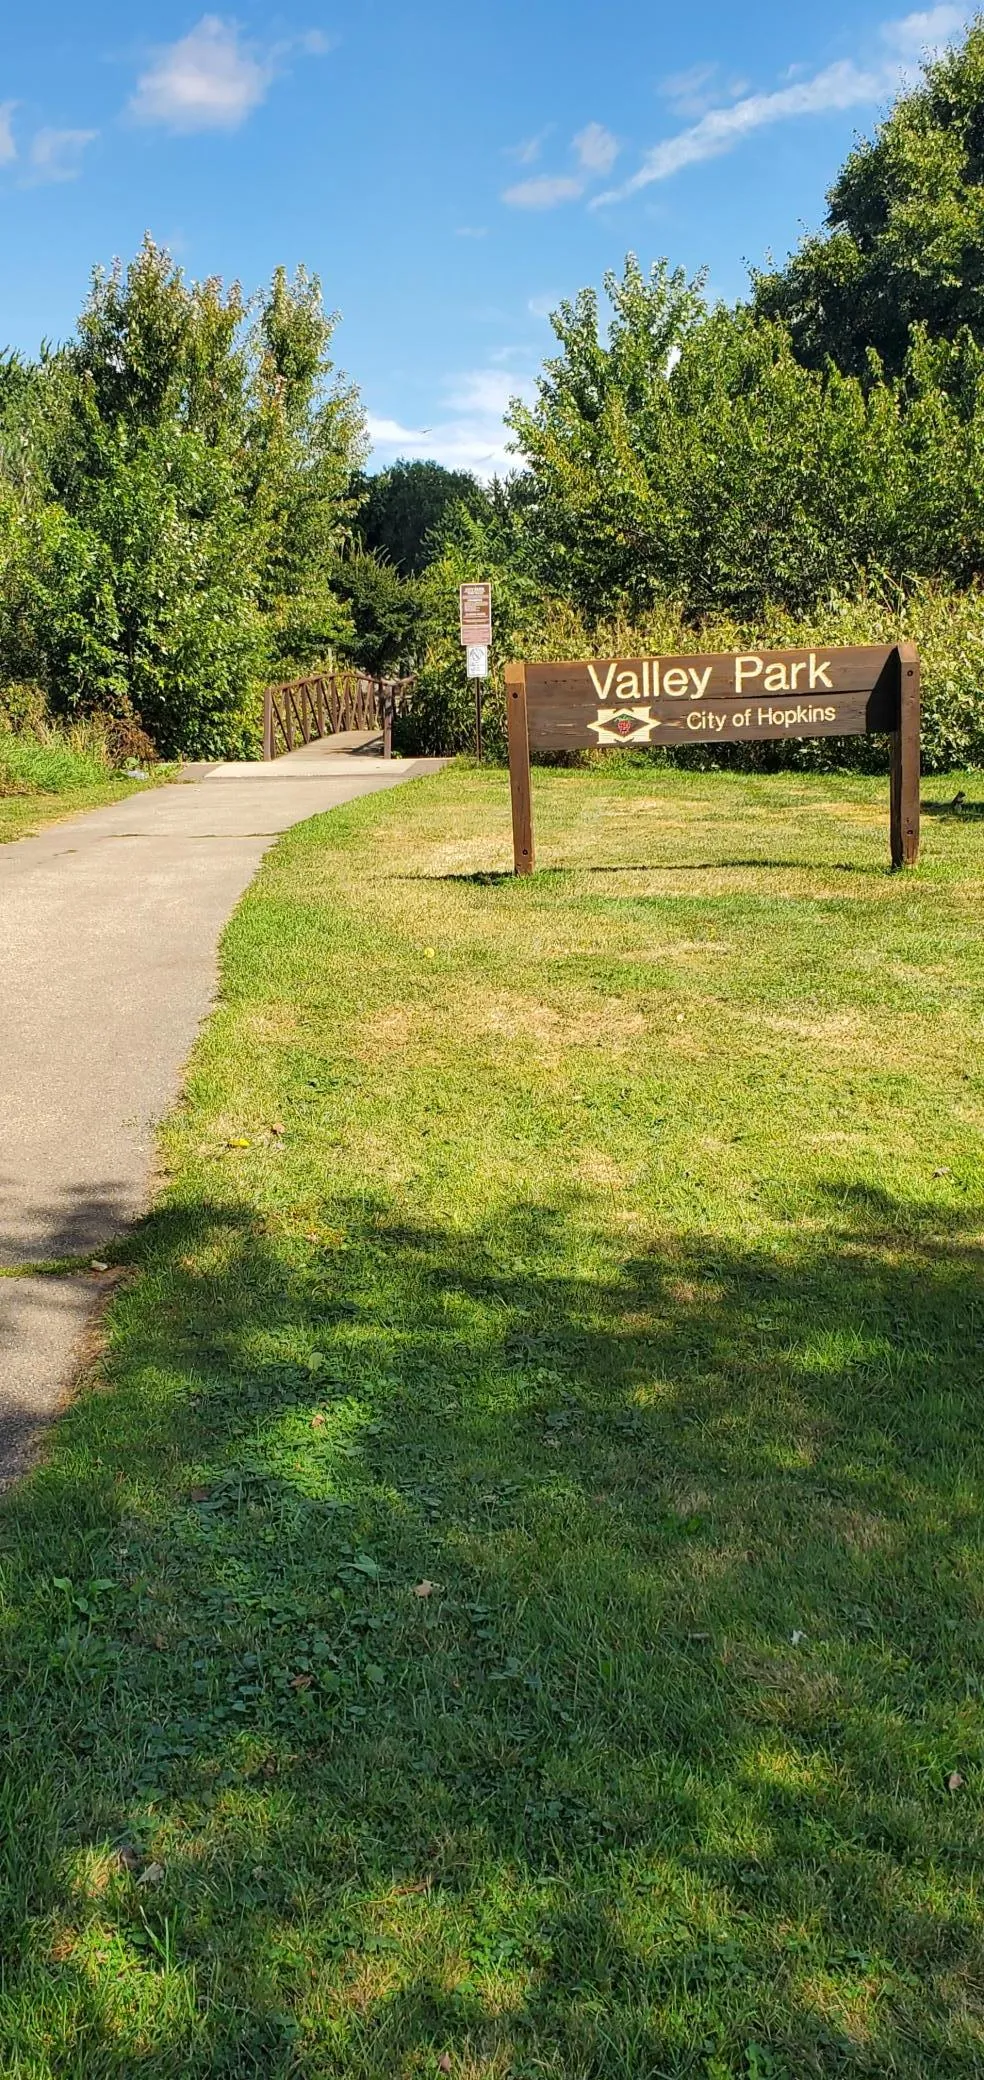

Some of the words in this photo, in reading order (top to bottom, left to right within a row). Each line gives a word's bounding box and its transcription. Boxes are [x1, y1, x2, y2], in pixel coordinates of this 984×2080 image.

[587, 660, 713, 700] Valley
[735, 652, 833, 694] Park
[686, 711, 728, 732] City
[732, 709, 752, 727] of
[758, 705, 837, 728] Hopkins
